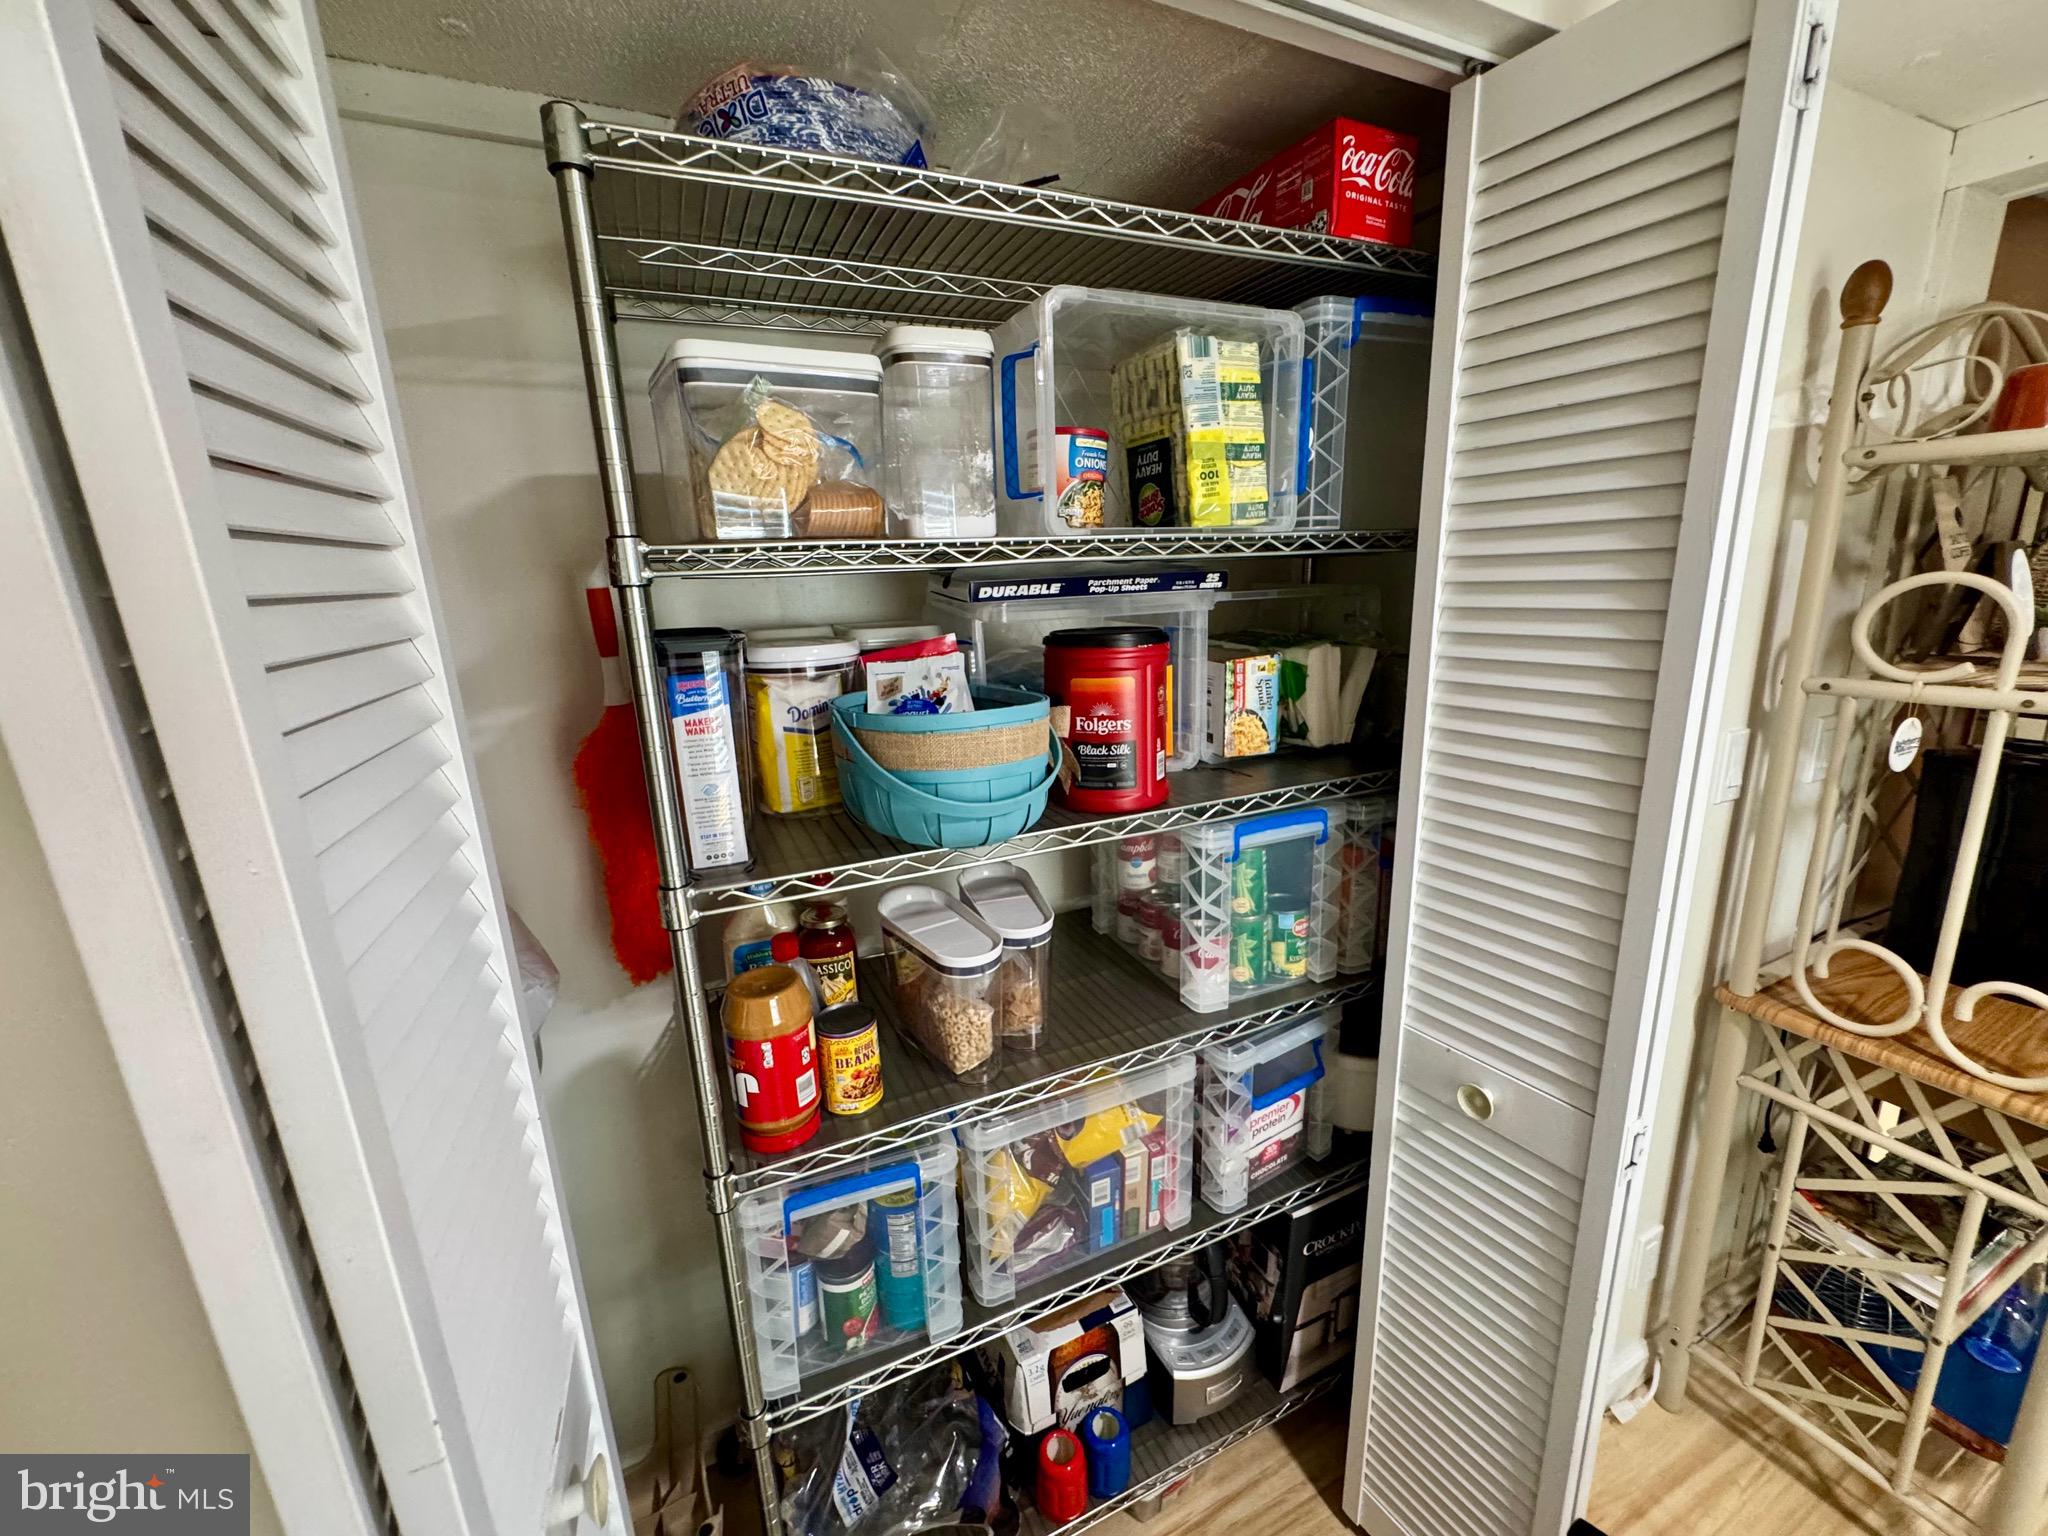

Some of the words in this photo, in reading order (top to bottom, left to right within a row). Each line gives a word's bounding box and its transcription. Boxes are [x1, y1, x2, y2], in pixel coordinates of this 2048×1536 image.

[698, 74, 750, 116] ULTRA
[1345, 190, 1382, 206] ORIGINAL
[1385, 200, 1407, 213] TASTE
[1074, 456, 1107, 471] ONIONS
[1137, 450, 1159, 465] DUTY
[1241, 452, 1262, 460] HEAVY
[1136, 462, 1163, 479] HEAVY
[1245, 510, 1266, 518] HEAVY
[1088, 578, 1133, 587] Parchment
[1134, 577, 1158, 585] Paper
[1205, 573, 1220, 583] 25
[978, 582, 1062, 599] DURABLE
[1089, 585, 1119, 593] Pop-Up
[1120, 583, 1148, 592] Sheets
[1255, 678, 1265, 711] Spuds
[1264, 678, 1274, 711] Idaho
[787, 699, 831, 723] Domin
[1075, 716, 1133, 735] Folgers
[1077, 744, 1109, 756] Black
[1109, 743, 1131, 756] Silk
[816, 959, 852, 976] ASSICO
[836, 1049, 876, 1069] BEANS
[1249, 1102, 1290, 1133] premier
[1251, 1113, 1287, 1141] protein
[1250, 1154, 1288, 1180] CHOCOLATE
[1303, 1222, 1356, 1256] CROCK-P
